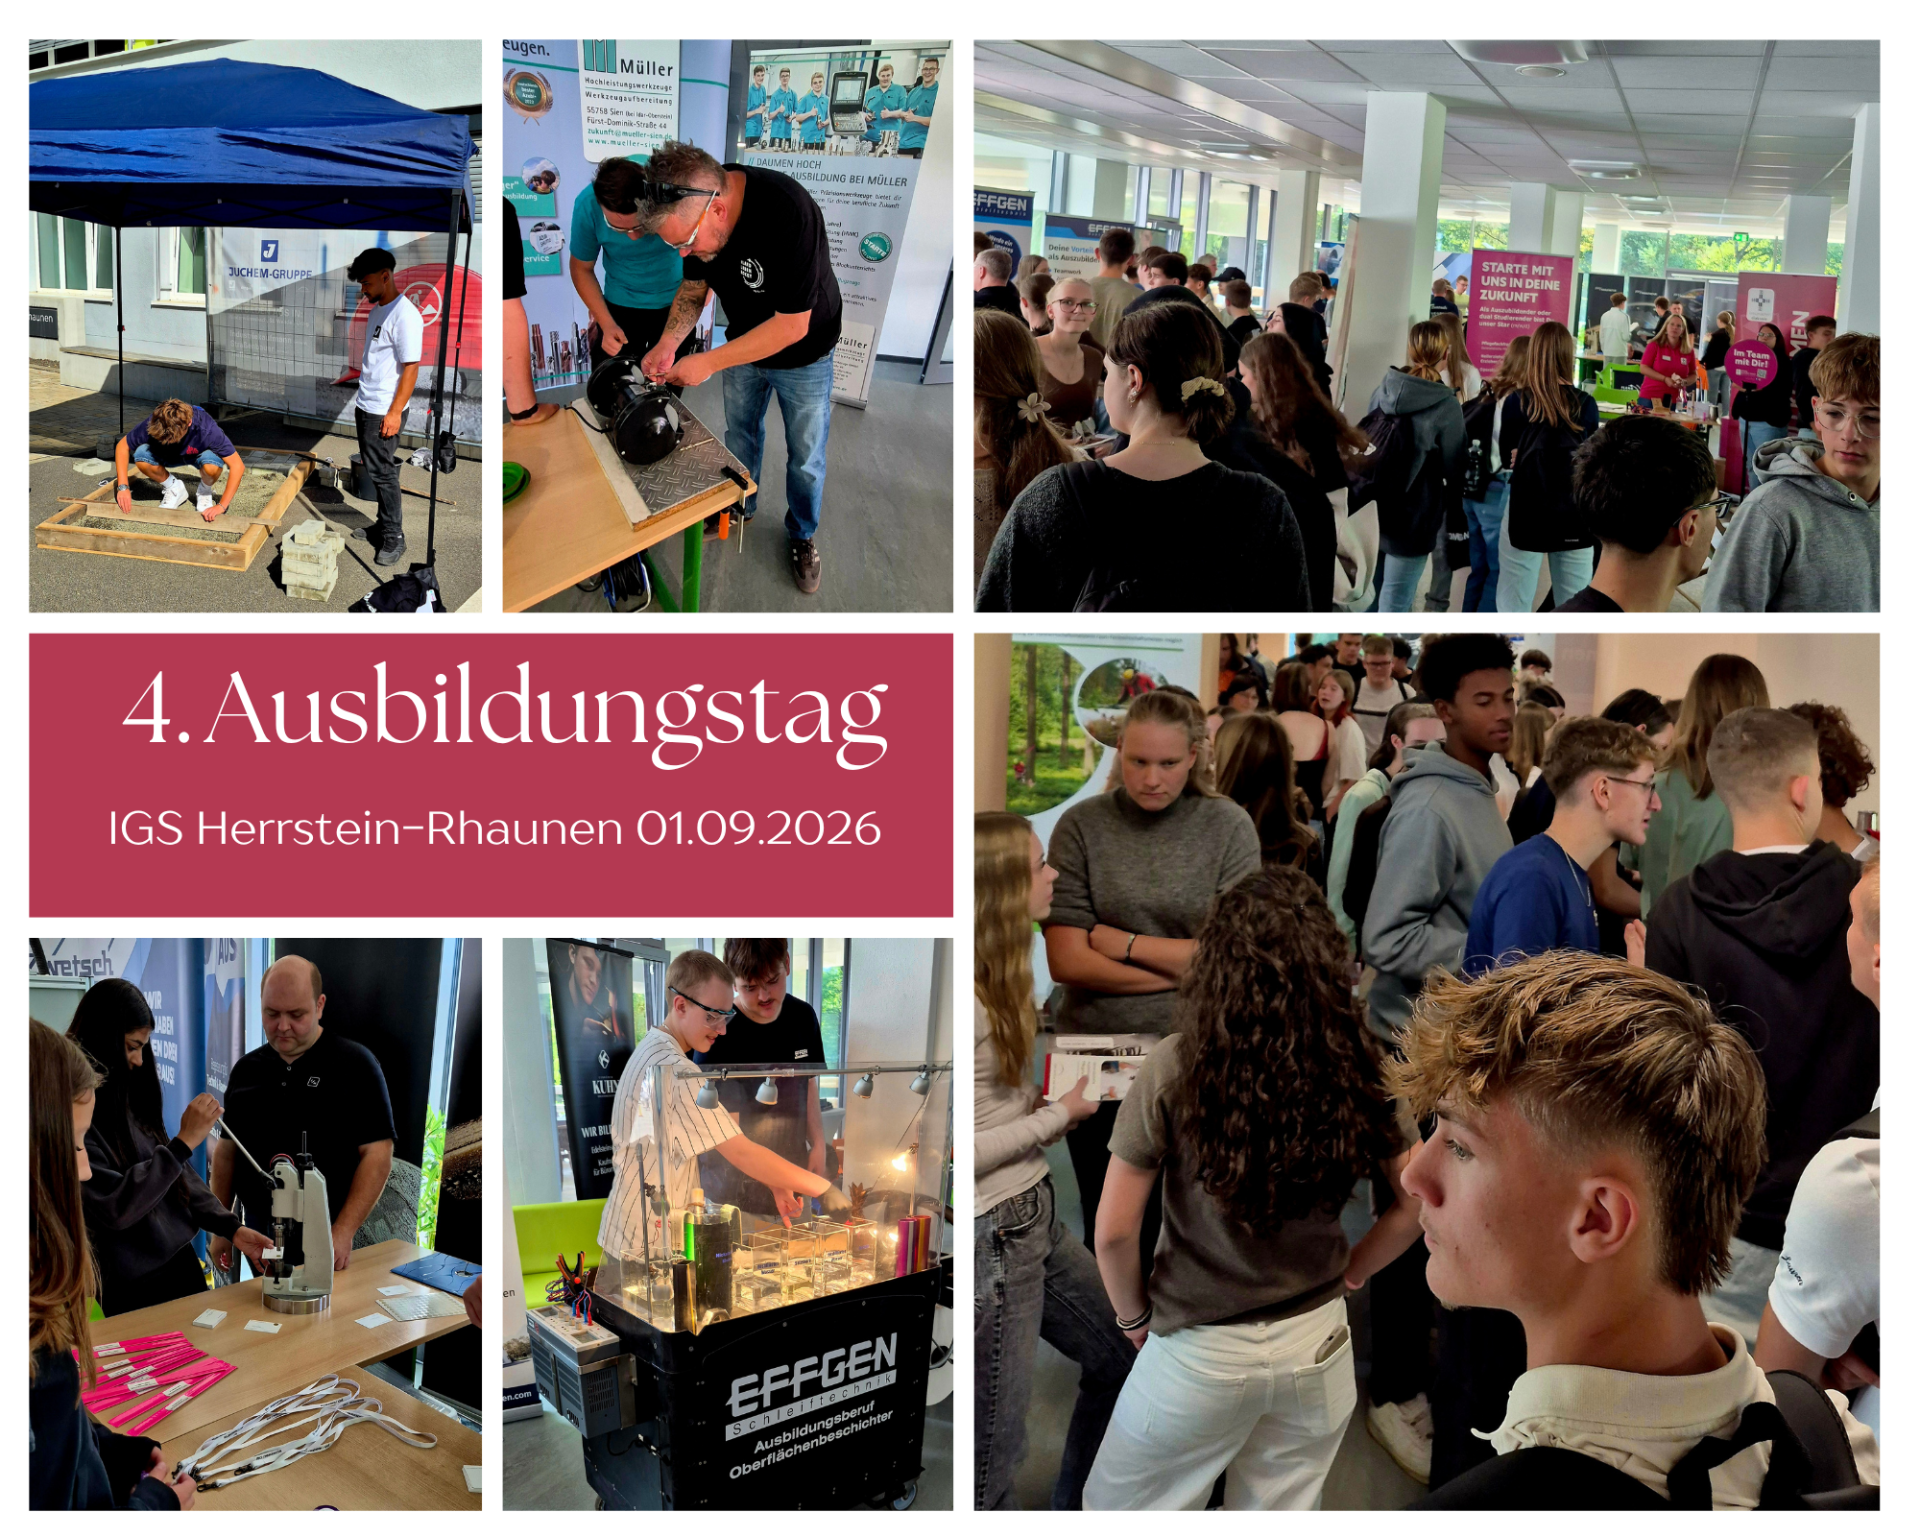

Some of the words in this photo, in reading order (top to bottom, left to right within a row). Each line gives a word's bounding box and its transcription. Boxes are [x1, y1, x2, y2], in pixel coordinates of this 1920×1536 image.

[503, 39, 550, 56] eugen.
[620, 58, 673, 76] Müller
[585, 77, 672, 92] Hochleistungswerkzeuge
[585, 91, 672, 106] Werkzeugaufbereitung
[587, 106, 608, 114] 55758
[610, 107, 624, 116] Sien
[587, 116, 657, 129] Fürst-Dominik-Straße
[757, 158, 794, 168] DAUMEN
[797, 160, 822, 169] HOCH
[790, 172, 847, 183] AUSBILDUNG
[849, 174, 865, 184] BEI
[868, 174, 908, 187] MÜLLER
[863, 238, 887, 257] STARTE
[1048, 244, 1070, 252] Deine
[228, 266, 313, 280] JUCHEM-GRUPPE
[1482, 261, 1528, 275] STARTE
[1531, 265, 1555, 276] MIT
[1481, 275, 1507, 287] UNS
[1509, 277, 1523, 289] IN
[1525, 278, 1561, 291] DEINE
[1479, 289, 1538, 303] ZUKUNFT
[1490, 306, 1536, 316] Auszubildender
[1493, 314, 1533, 323] Studierender
[1733, 349, 1745, 357] Im
[1746, 350, 1770, 360] Team
[1734, 358, 1750, 366] mit
[1751, 359, 1769, 368] Dir!
[143, 990, 162, 1010] WIR
[581, 1126, 598, 1138] WIR
[726, 1332, 897, 1417] EFFGEN
[732, 1373, 892, 1436] Schleiftechnik
[754, 1400, 875, 1454] Ausbildungsberuf
[729, 1410, 894, 1479] Oberflächenbeschichter
